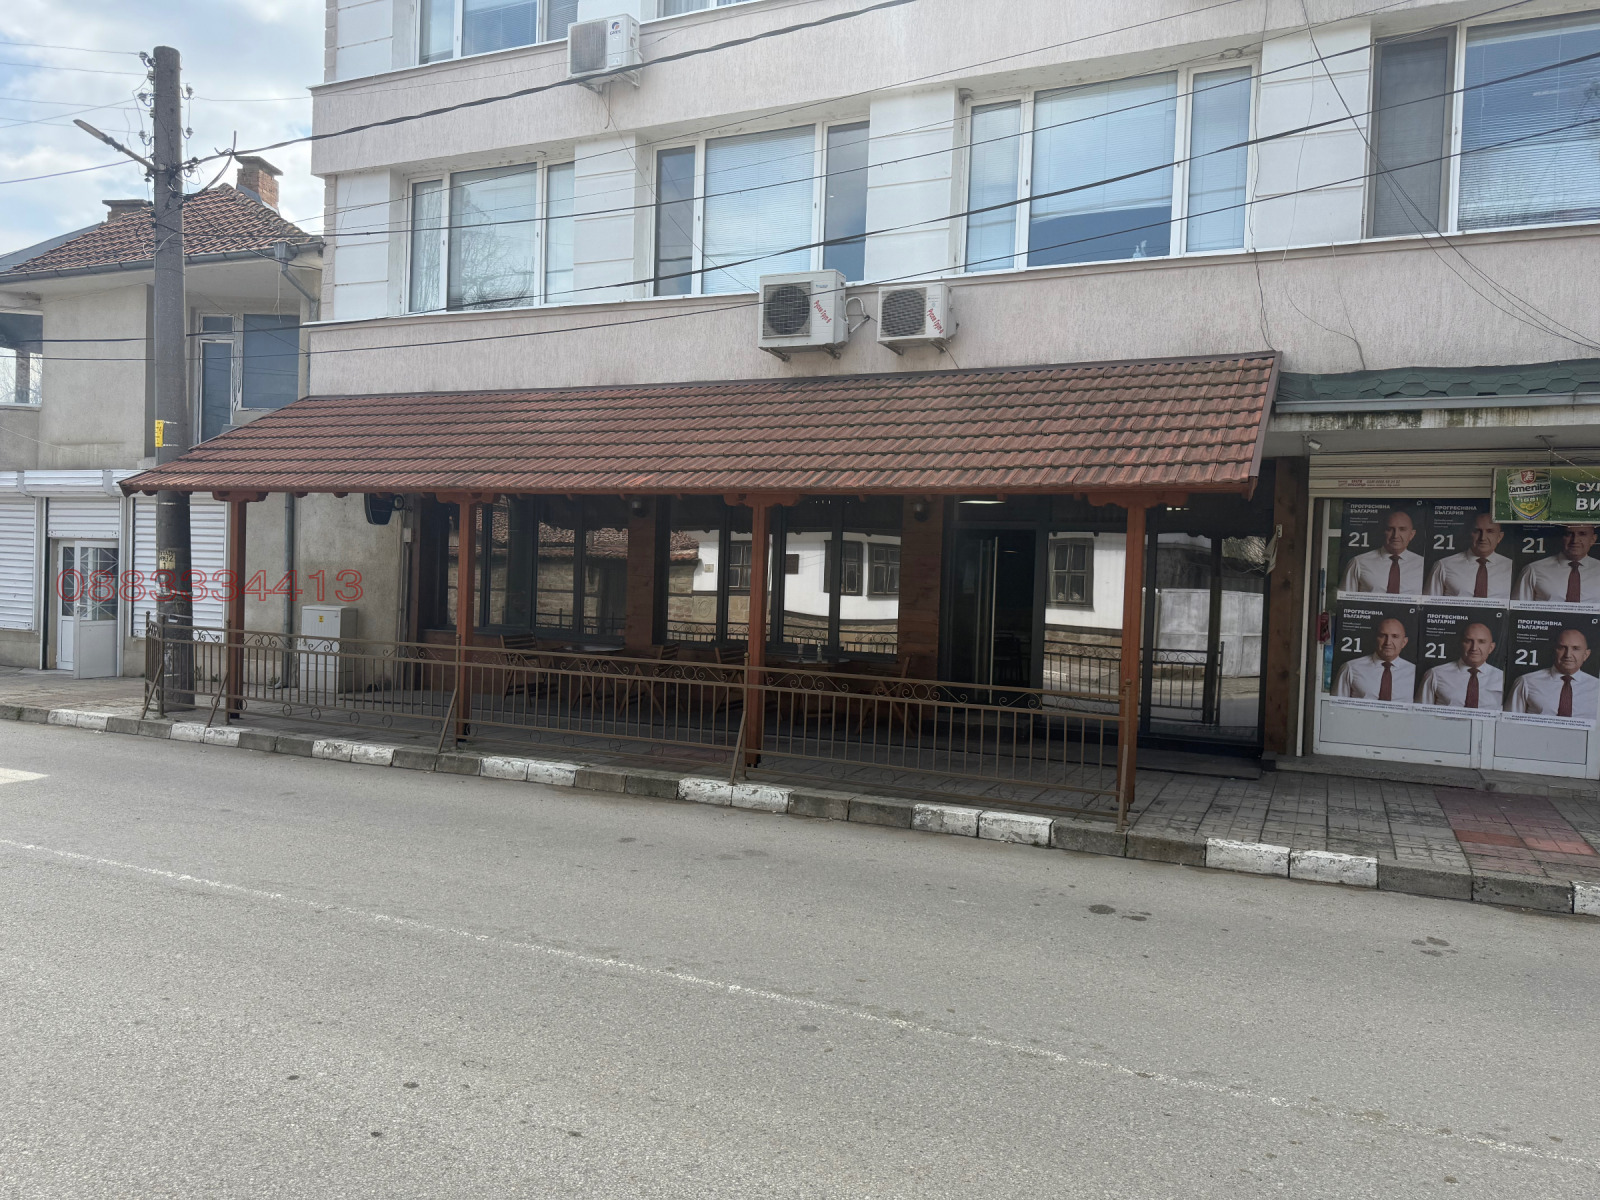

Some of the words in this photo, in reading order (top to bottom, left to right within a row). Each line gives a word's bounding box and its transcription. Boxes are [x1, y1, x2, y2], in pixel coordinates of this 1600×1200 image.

[1348, 531, 1370, 547] 21
[1433, 534, 1455, 550] 21
[1521, 537, 1546, 553] 21
[1340, 636, 1362, 653] 21
[1424, 642, 1447, 659] 21
[1515, 648, 1539, 666] 21
